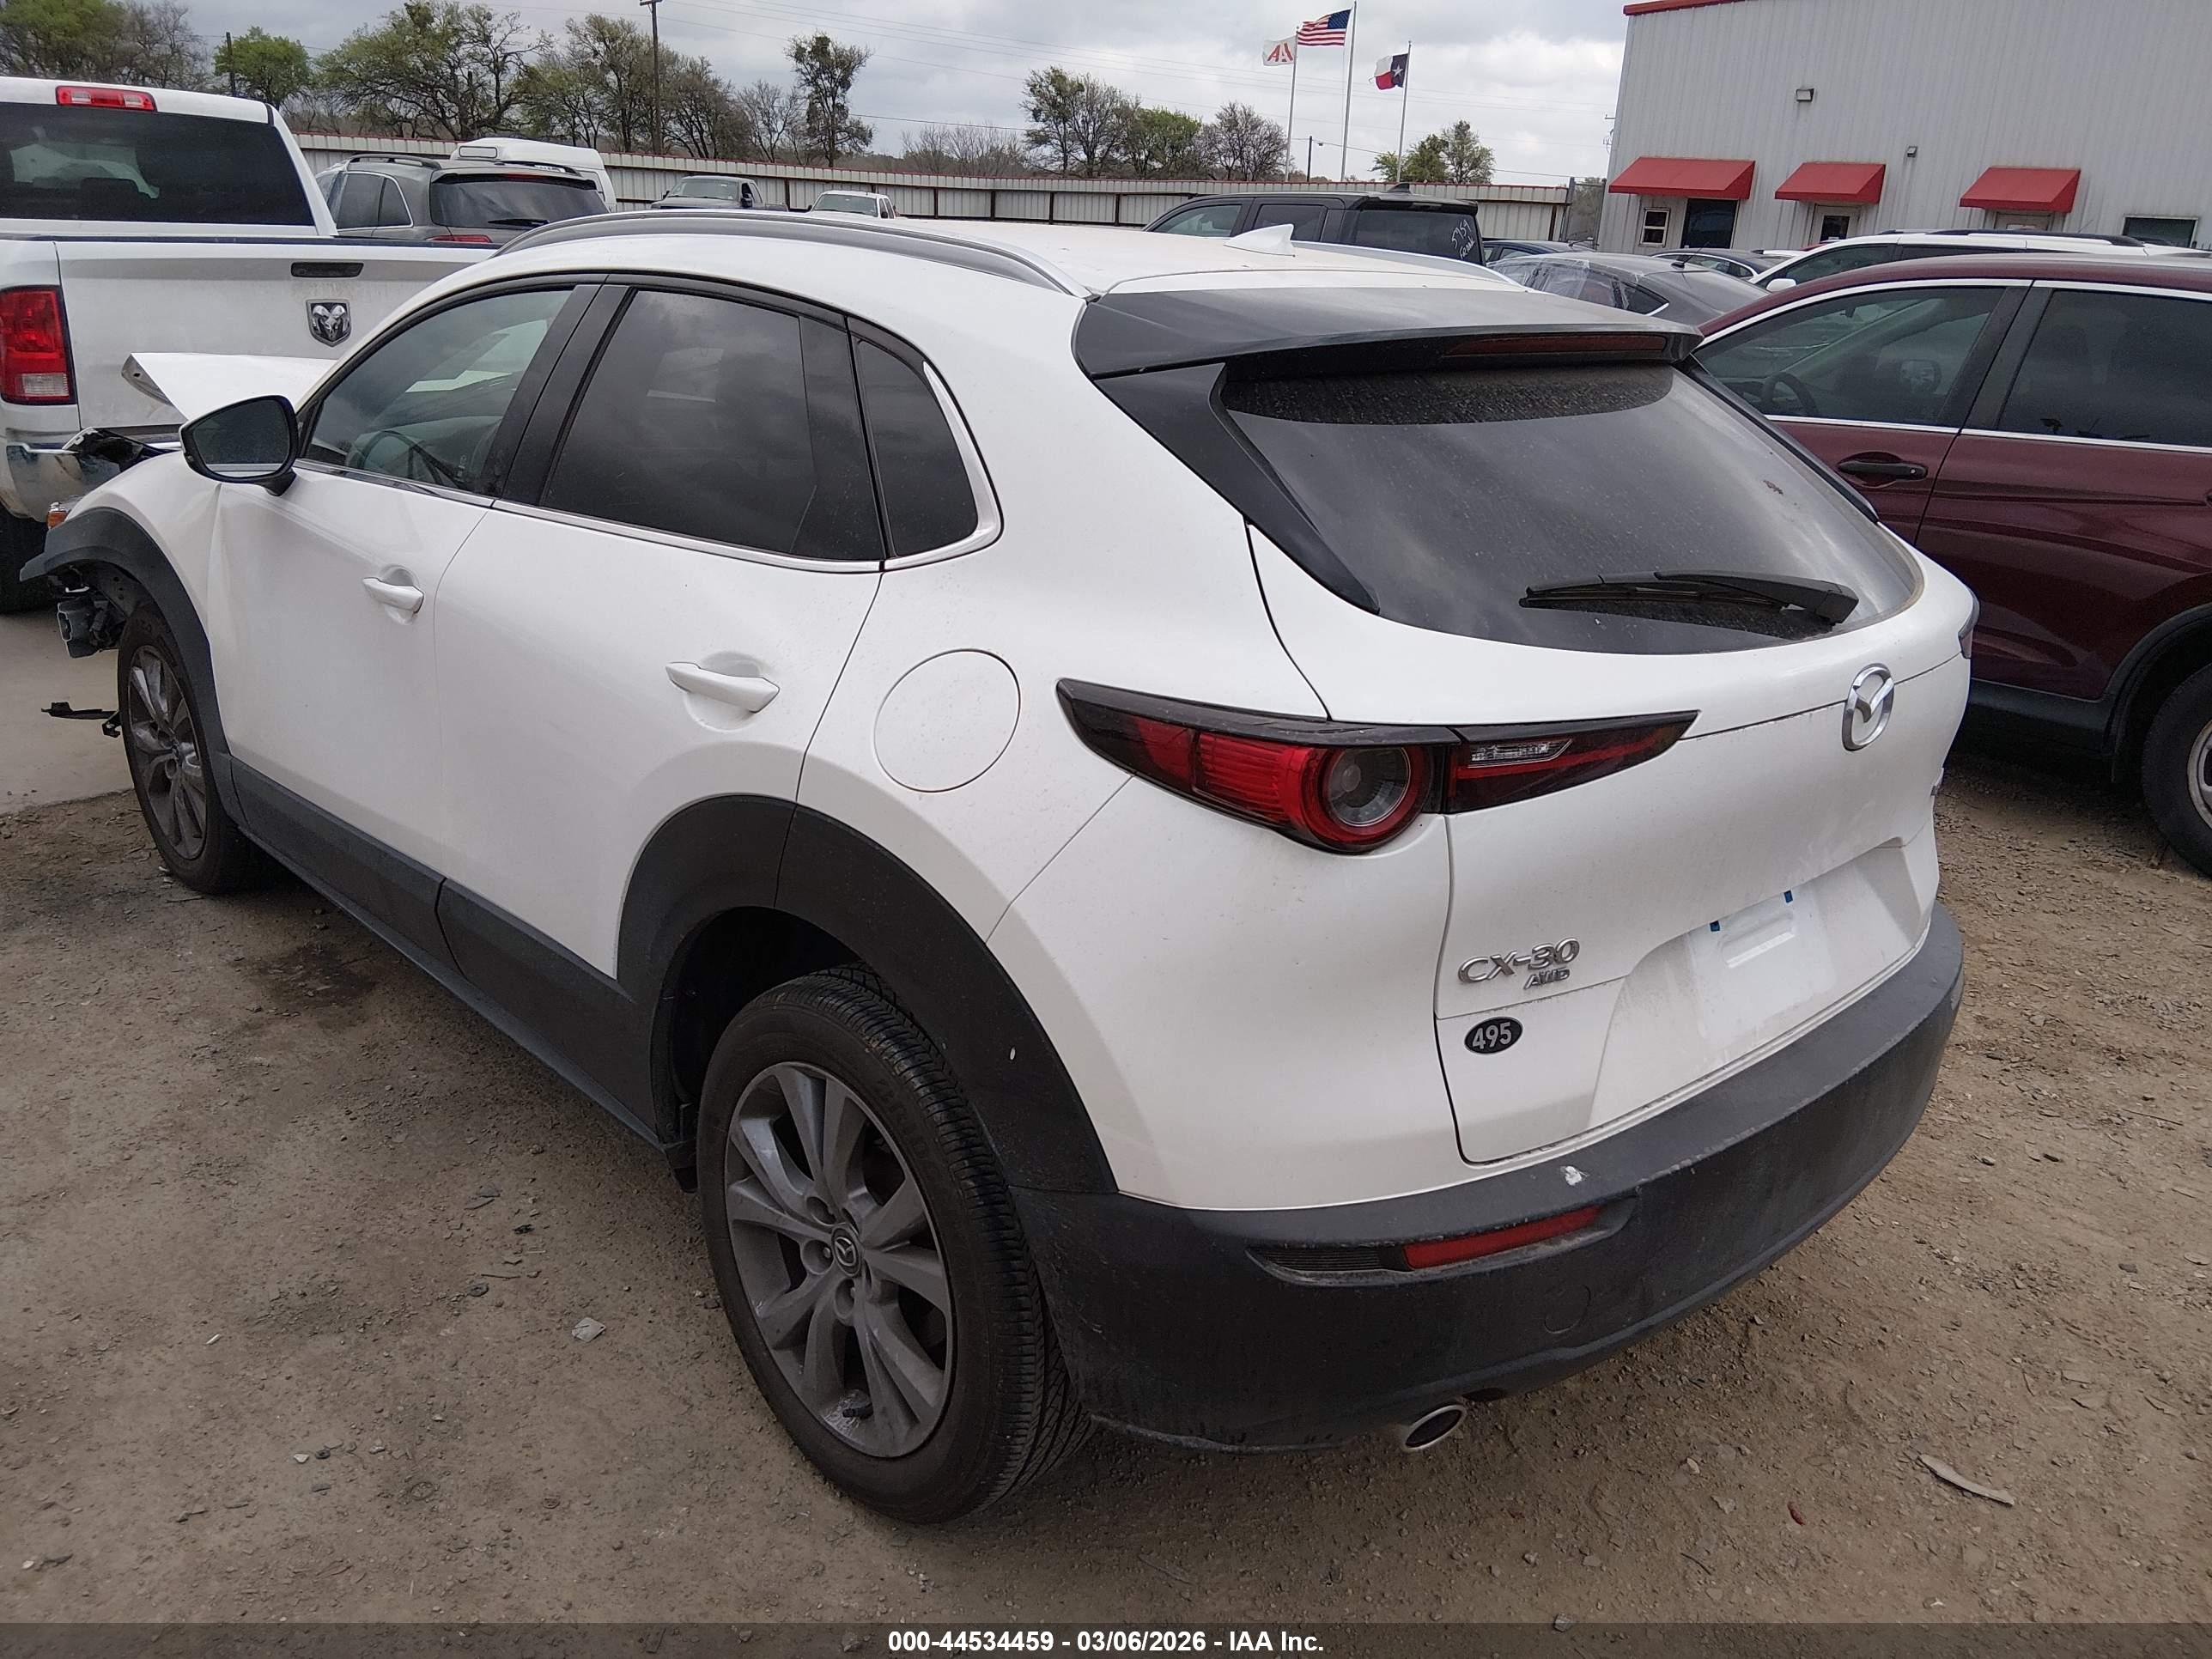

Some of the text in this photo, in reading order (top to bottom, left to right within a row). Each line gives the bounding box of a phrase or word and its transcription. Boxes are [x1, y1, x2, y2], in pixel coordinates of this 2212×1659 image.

[1458, 937, 1580, 983] CX-30
[1523, 967, 1571, 989] AWD
[1472, 1022, 1512, 1049] 495
